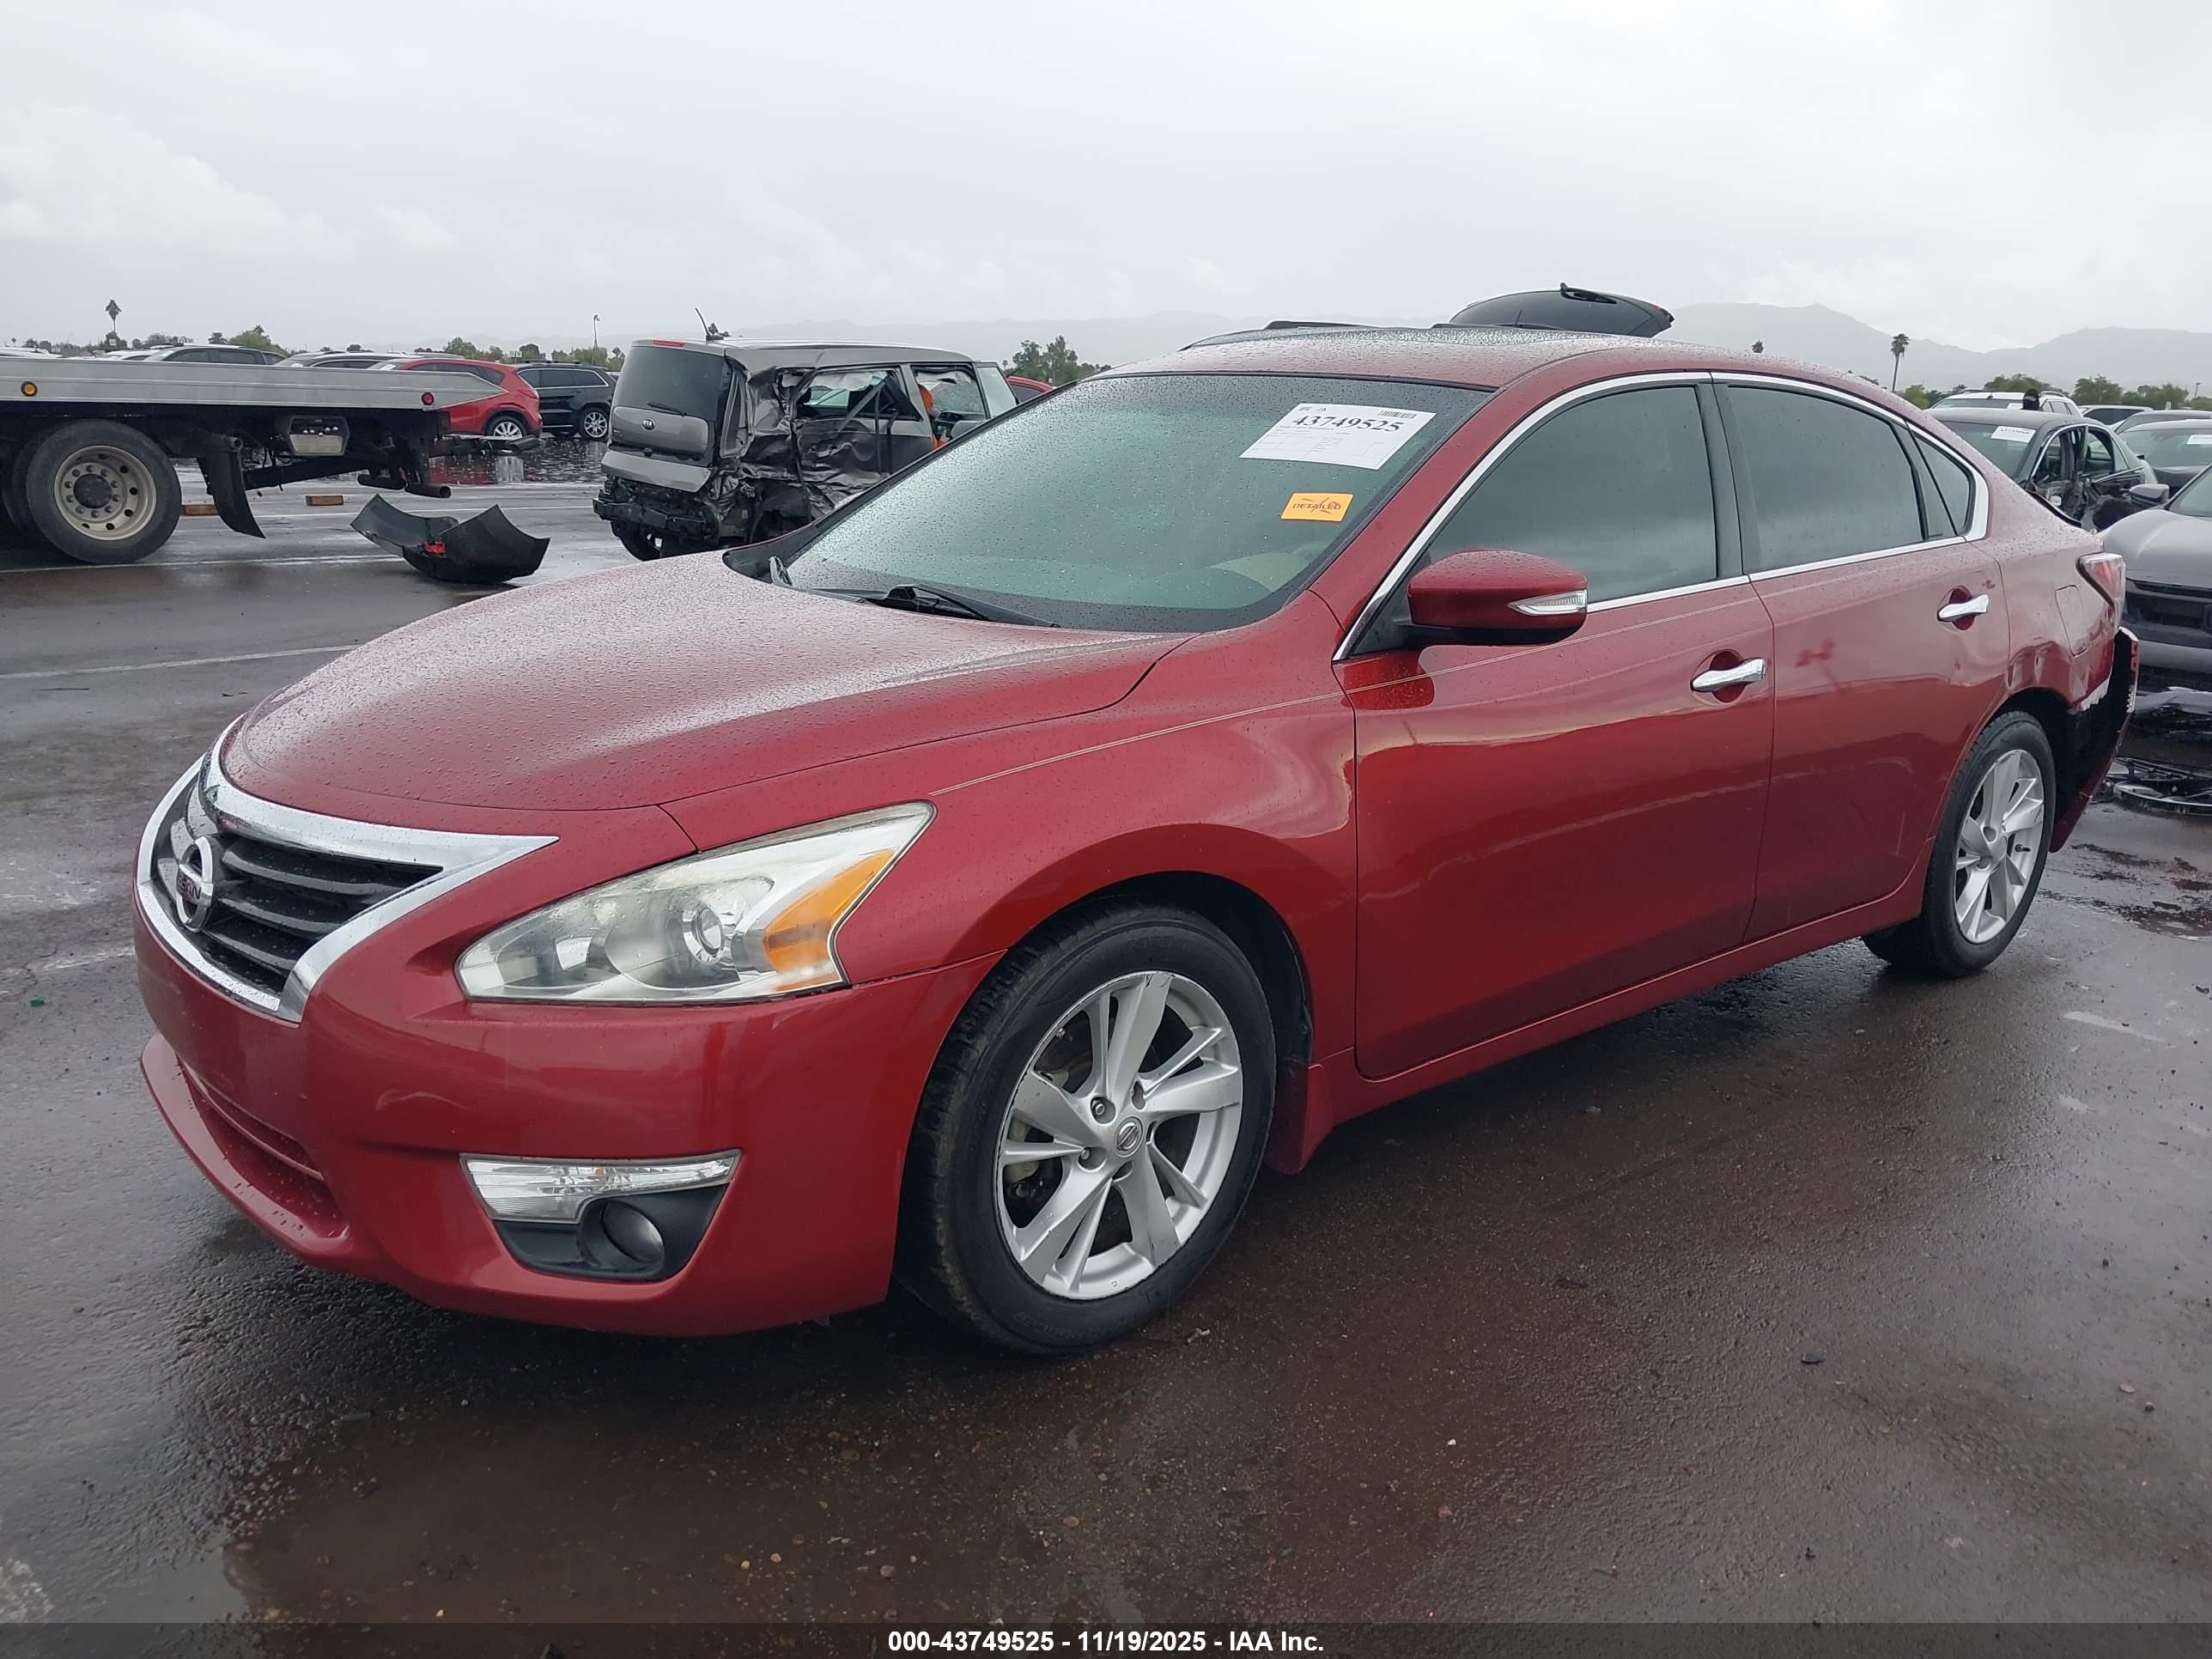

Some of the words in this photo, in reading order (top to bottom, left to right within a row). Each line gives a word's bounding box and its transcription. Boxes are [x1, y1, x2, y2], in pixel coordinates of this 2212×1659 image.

[642, 419, 653, 428] KIA
[1292, 415, 1405, 432] 43749525
[1291, 501, 1342, 510] DETAILED
